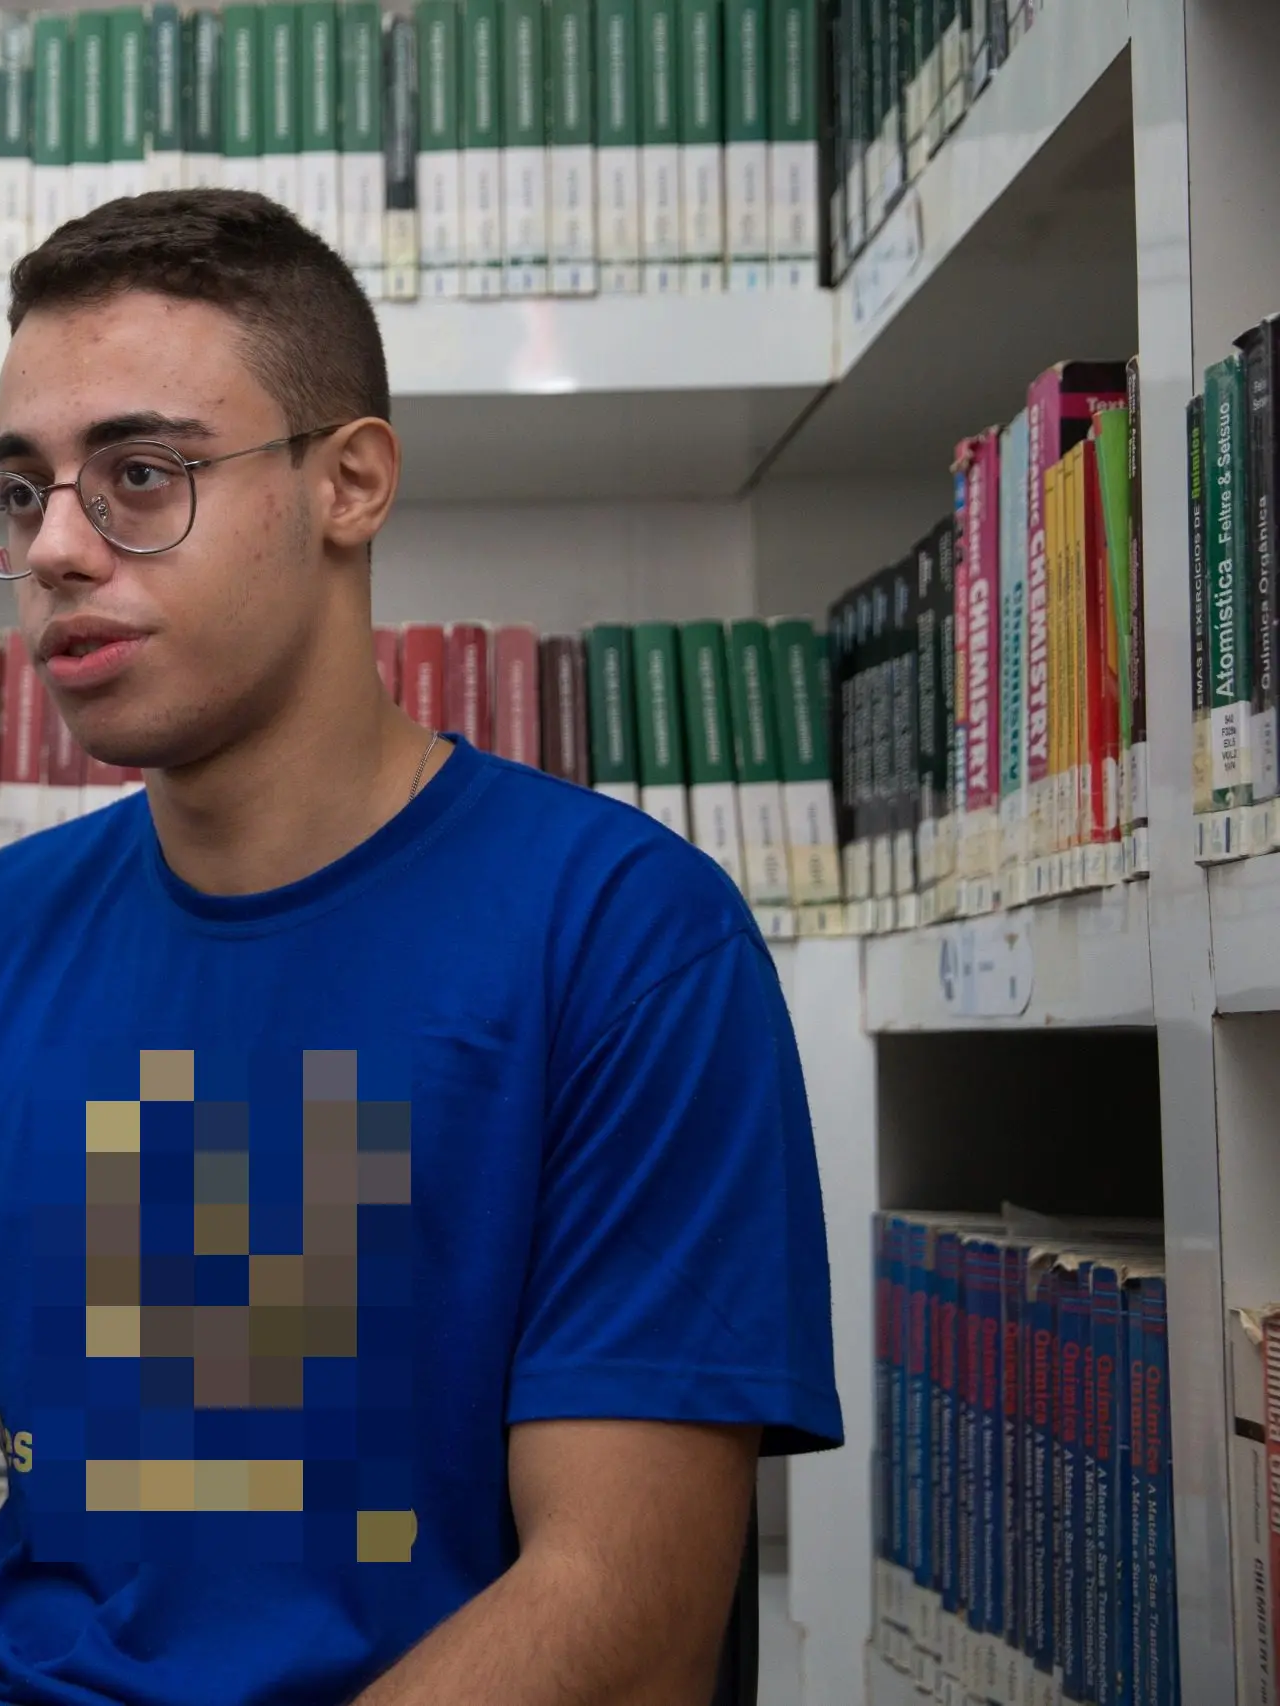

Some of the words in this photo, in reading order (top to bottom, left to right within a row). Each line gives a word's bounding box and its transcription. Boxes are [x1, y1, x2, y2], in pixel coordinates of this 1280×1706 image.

[1217, 402, 1232, 468] Setsuo
[1217, 471, 1232, 485] &
[1193, 504, 1201, 528] DE
[1218, 490, 1234, 544] Feltre
[1257, 494, 1272, 594] Orgânica
[1030, 529, 1047, 758] CHEMISTRY
[1214, 558, 1235, 697] Atomística
[970, 578, 989, 788] CHEMISTRY
[1063, 1341, 1080, 1442] Química
[1097, 1354, 1114, 1461] Química
[1146, 1365, 1162, 1476] Química
[1097, 1467, 1108, 1479] A
[1131, 1473, 1141, 1486] A
[1147, 1484, 1159, 1494] A
[1097, 1482, 1108, 1537] Matéria
[1131, 1490, 1141, 1546] Matéria
[1147, 1500, 1159, 1557] Matéria
[1097, 1553, 1108, 1587] Suas
[1131, 1562, 1141, 1598] Suas
[1147, 1560, 1157, 1570] e
[1147, 1573, 1159, 1609] Suas
[1255, 1558, 1269, 1676] CHEMISTRY
[1097, 1590, 1108, 1704] Transformações
